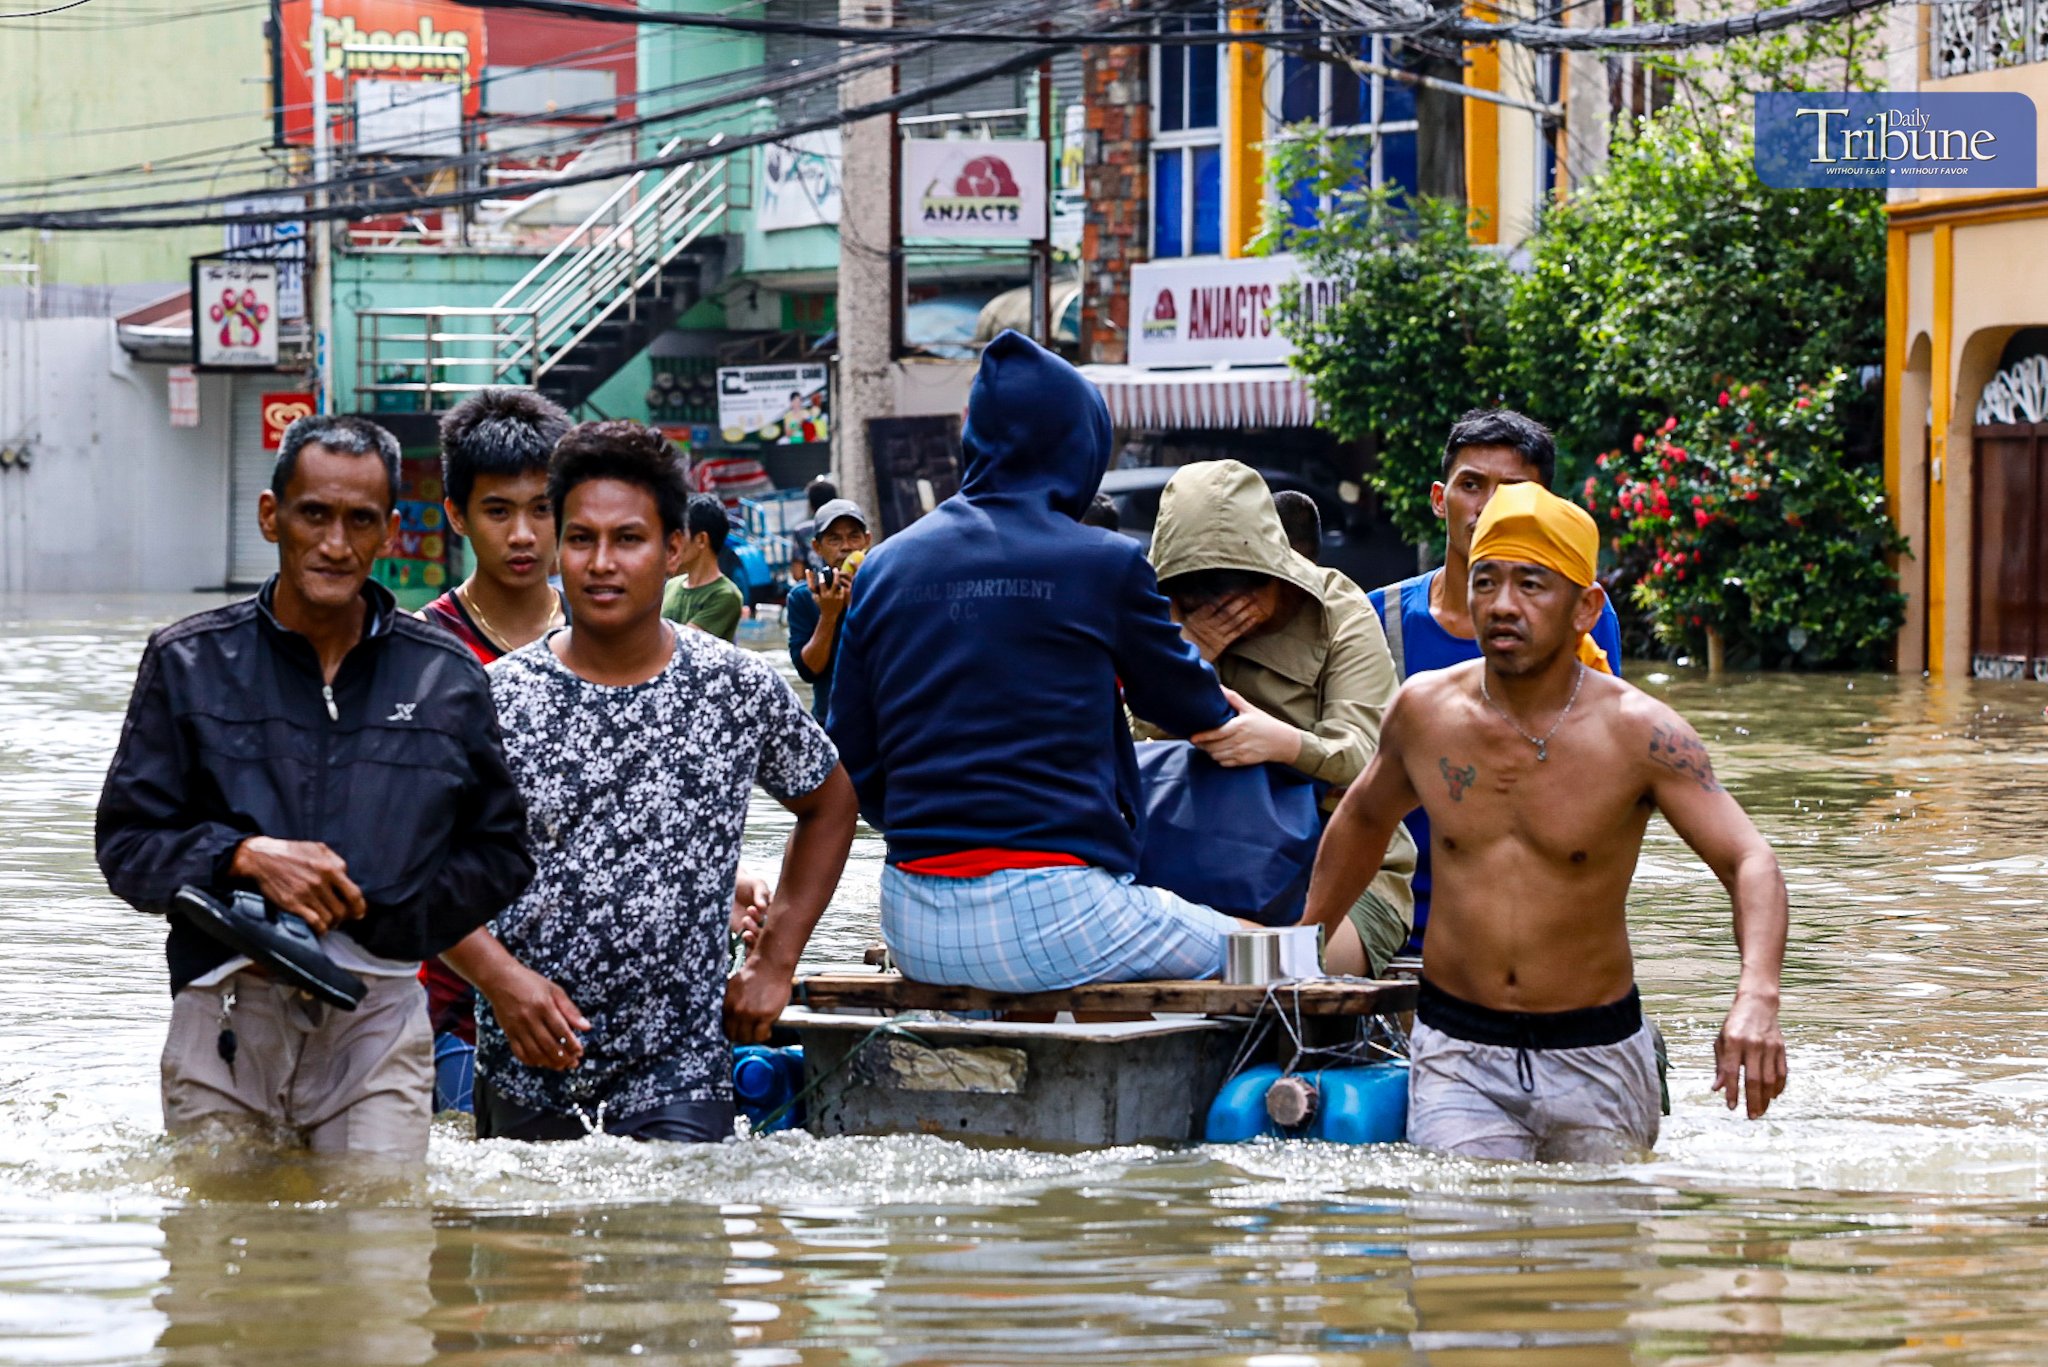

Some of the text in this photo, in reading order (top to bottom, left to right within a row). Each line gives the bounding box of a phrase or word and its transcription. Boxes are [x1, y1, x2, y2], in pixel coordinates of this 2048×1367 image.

[923, 205, 1019, 221] ANJACTS
[1188, 284, 1272, 339] ANJACTS
[946, 578, 1056, 600] DEPARTMENT
